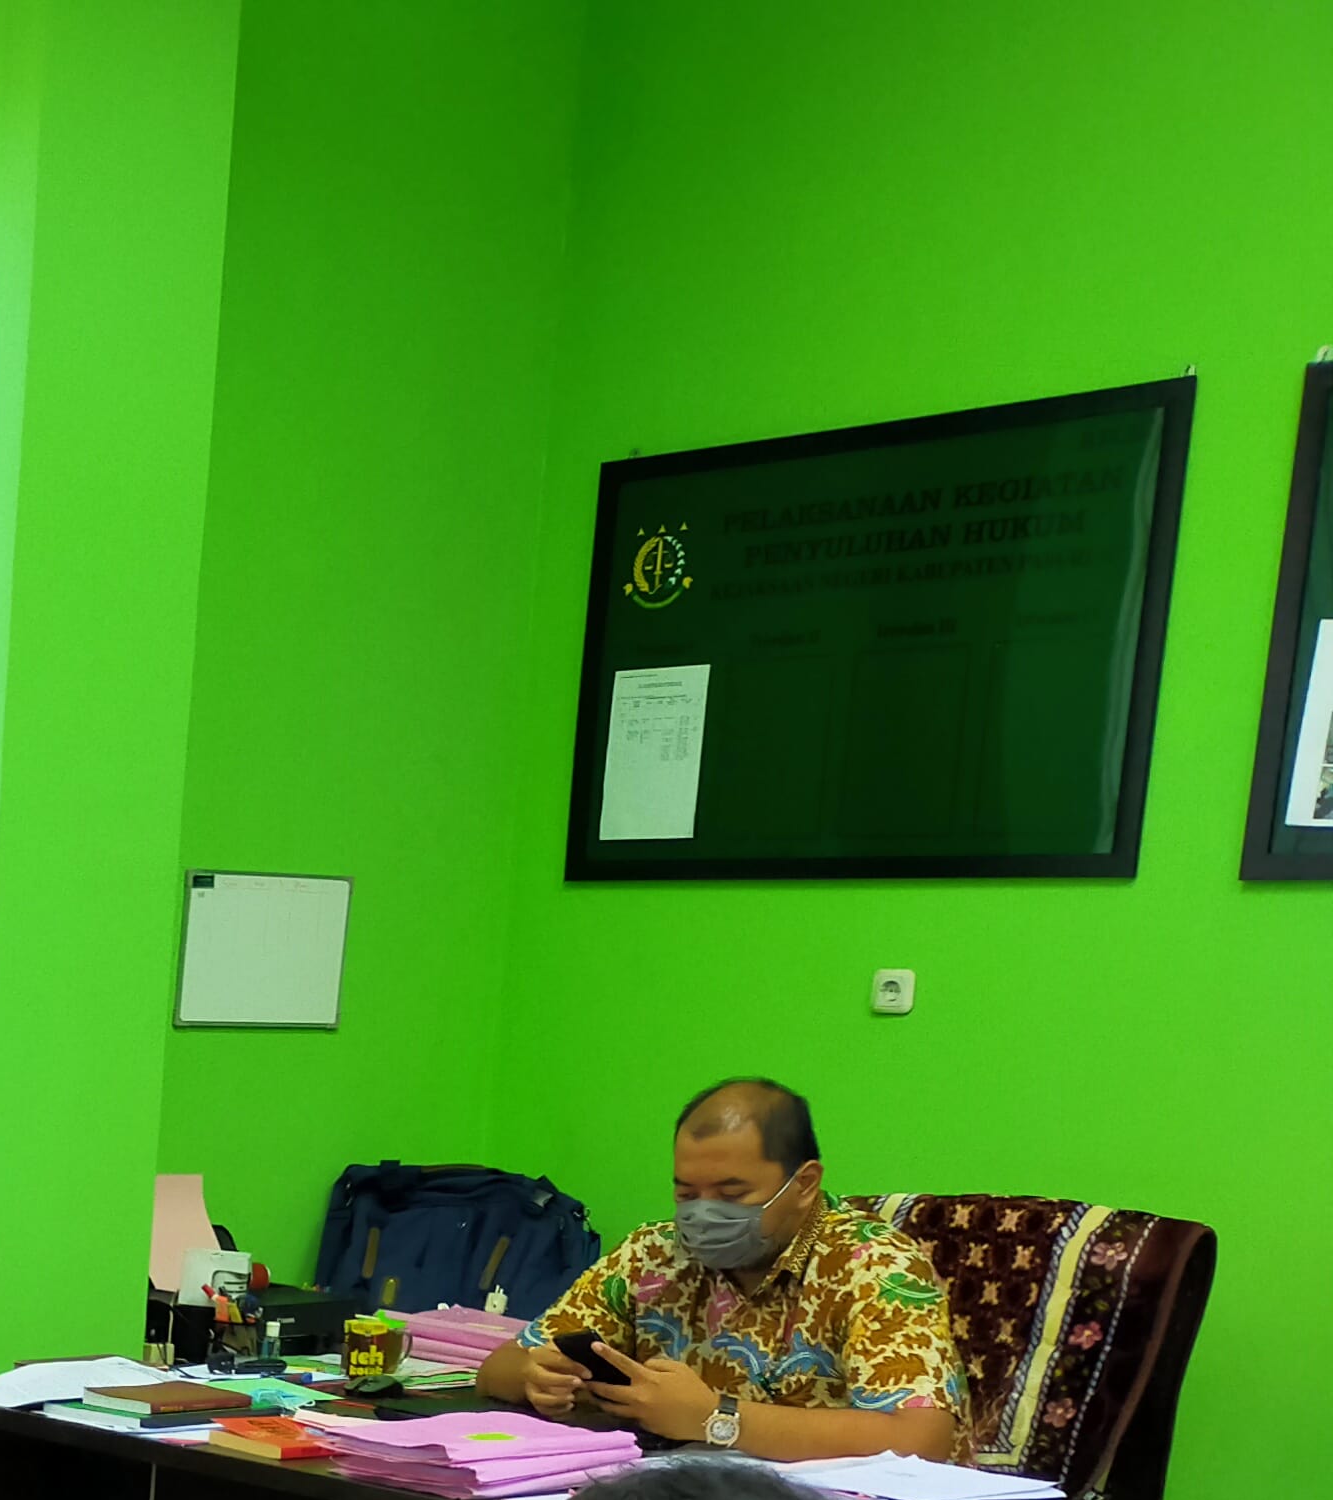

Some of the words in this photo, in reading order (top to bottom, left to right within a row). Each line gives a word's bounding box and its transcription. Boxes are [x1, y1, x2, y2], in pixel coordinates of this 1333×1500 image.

[722, 487, 944, 534] PELAKSANAAN
[953, 464, 1127, 509] KEGIATAN
[743, 524, 953, 568] PENYULUHAN
[962, 508, 1090, 546] HUKUM
[350, 1344, 384, 1365] teh
